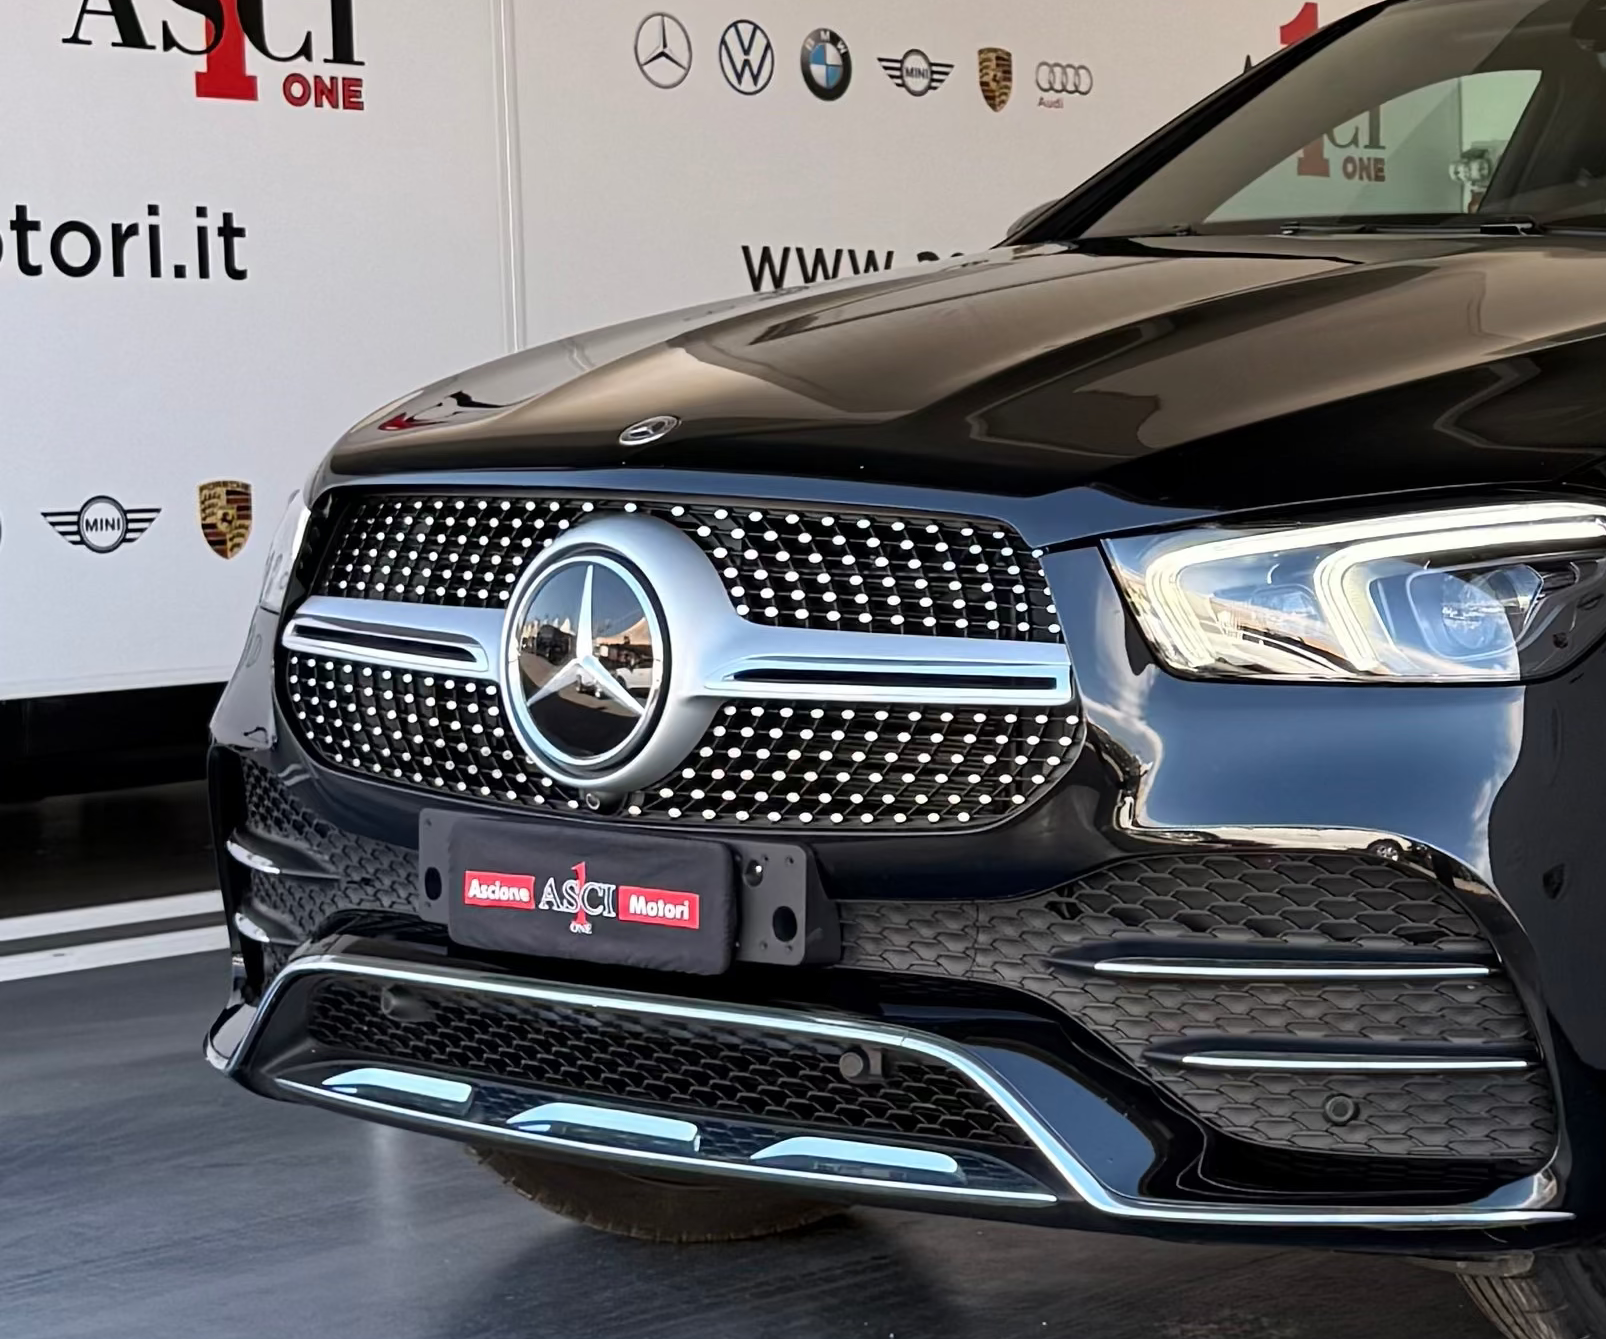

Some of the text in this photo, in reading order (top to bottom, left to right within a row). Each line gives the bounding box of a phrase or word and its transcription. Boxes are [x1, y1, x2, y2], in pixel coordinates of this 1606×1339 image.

[904, 67, 929, 79] MINI
[282, 76, 365, 110] ONE
[1037, 96, 1064, 109] Audi
[1342, 157, 1385, 182] ONE
[0, 204, 248, 281] tori.it
[84, 517, 121, 533] MINI
[468, 877, 690, 921] Ascione ASCI Motori
